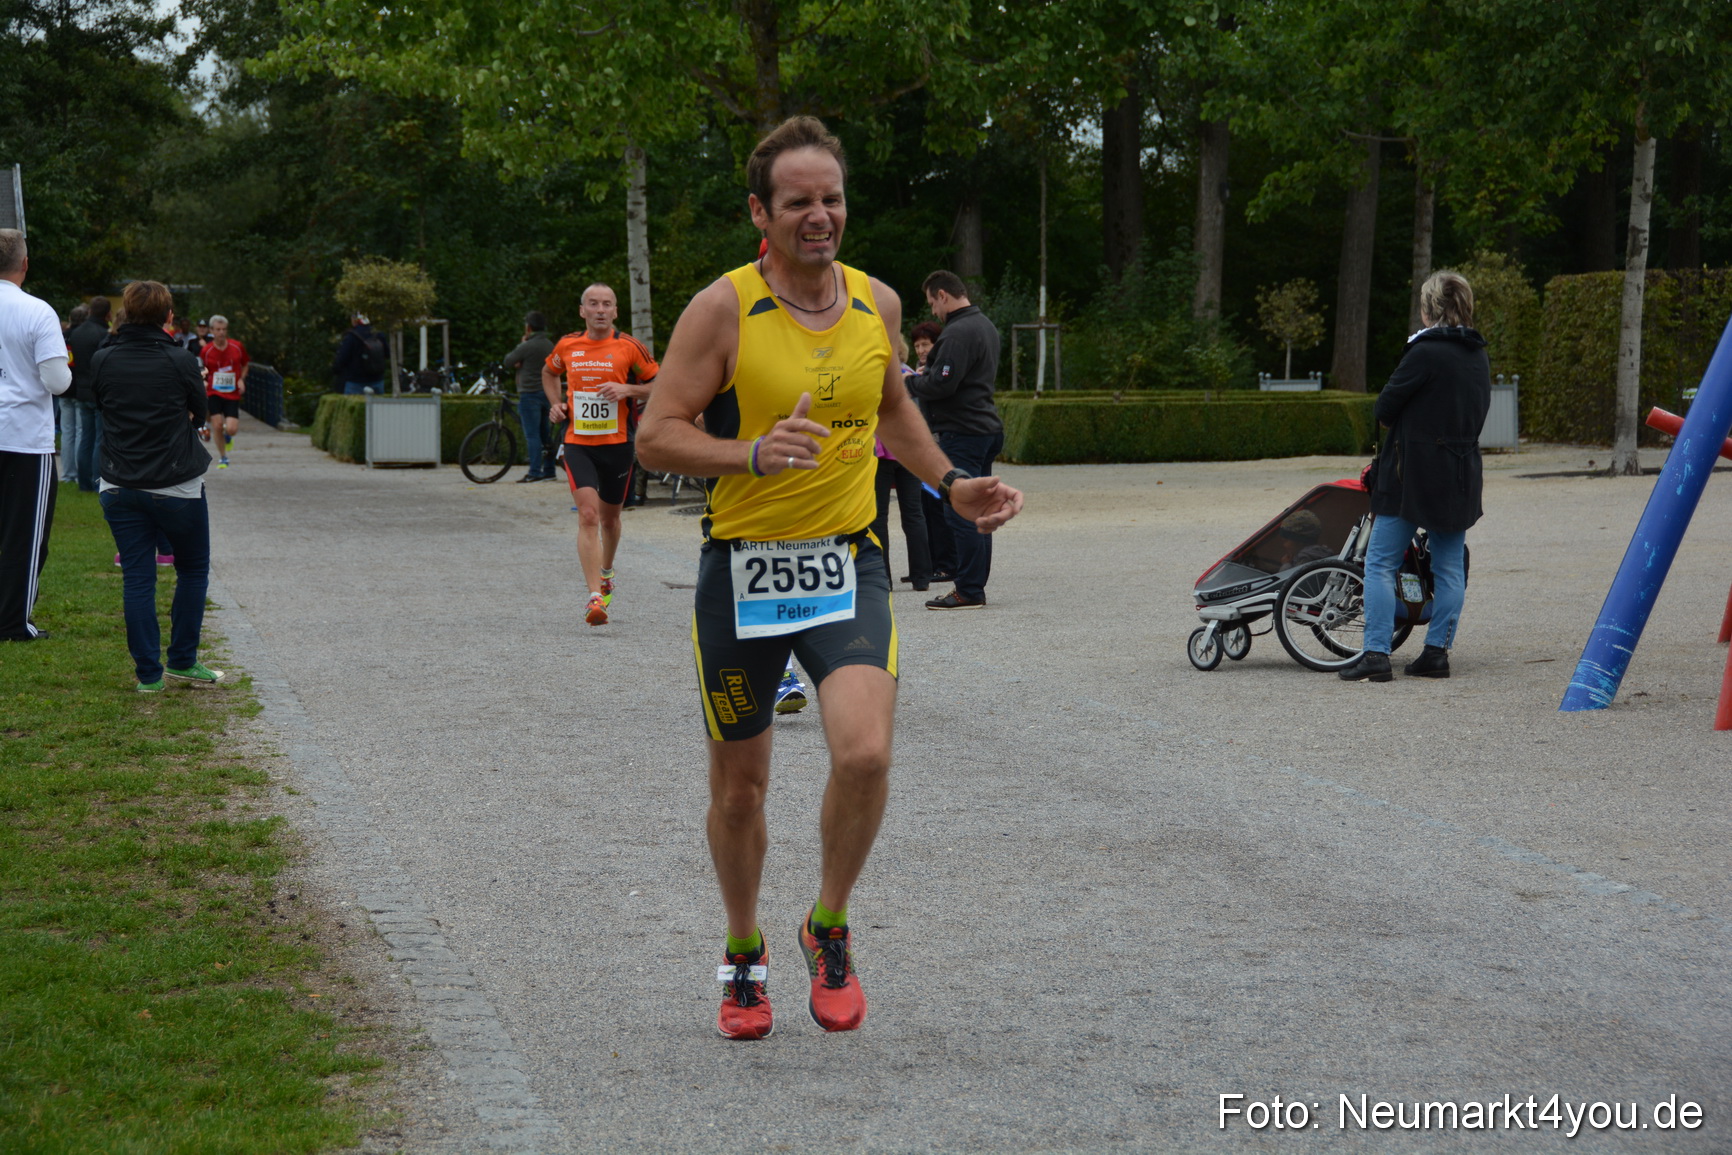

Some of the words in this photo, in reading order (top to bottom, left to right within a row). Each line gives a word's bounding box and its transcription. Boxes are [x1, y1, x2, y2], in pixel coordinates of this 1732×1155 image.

[571, 360, 614, 368] SportScheck
[581, 402, 610, 419] 205
[582, 422, 608, 430] Berthold
[776, 539, 831, 551] Neumarkt
[745, 551, 845, 594] 2559
[776, 603, 819, 620] Peter
[726, 674, 753, 712] Run!
[717, 694, 735, 722] Team
